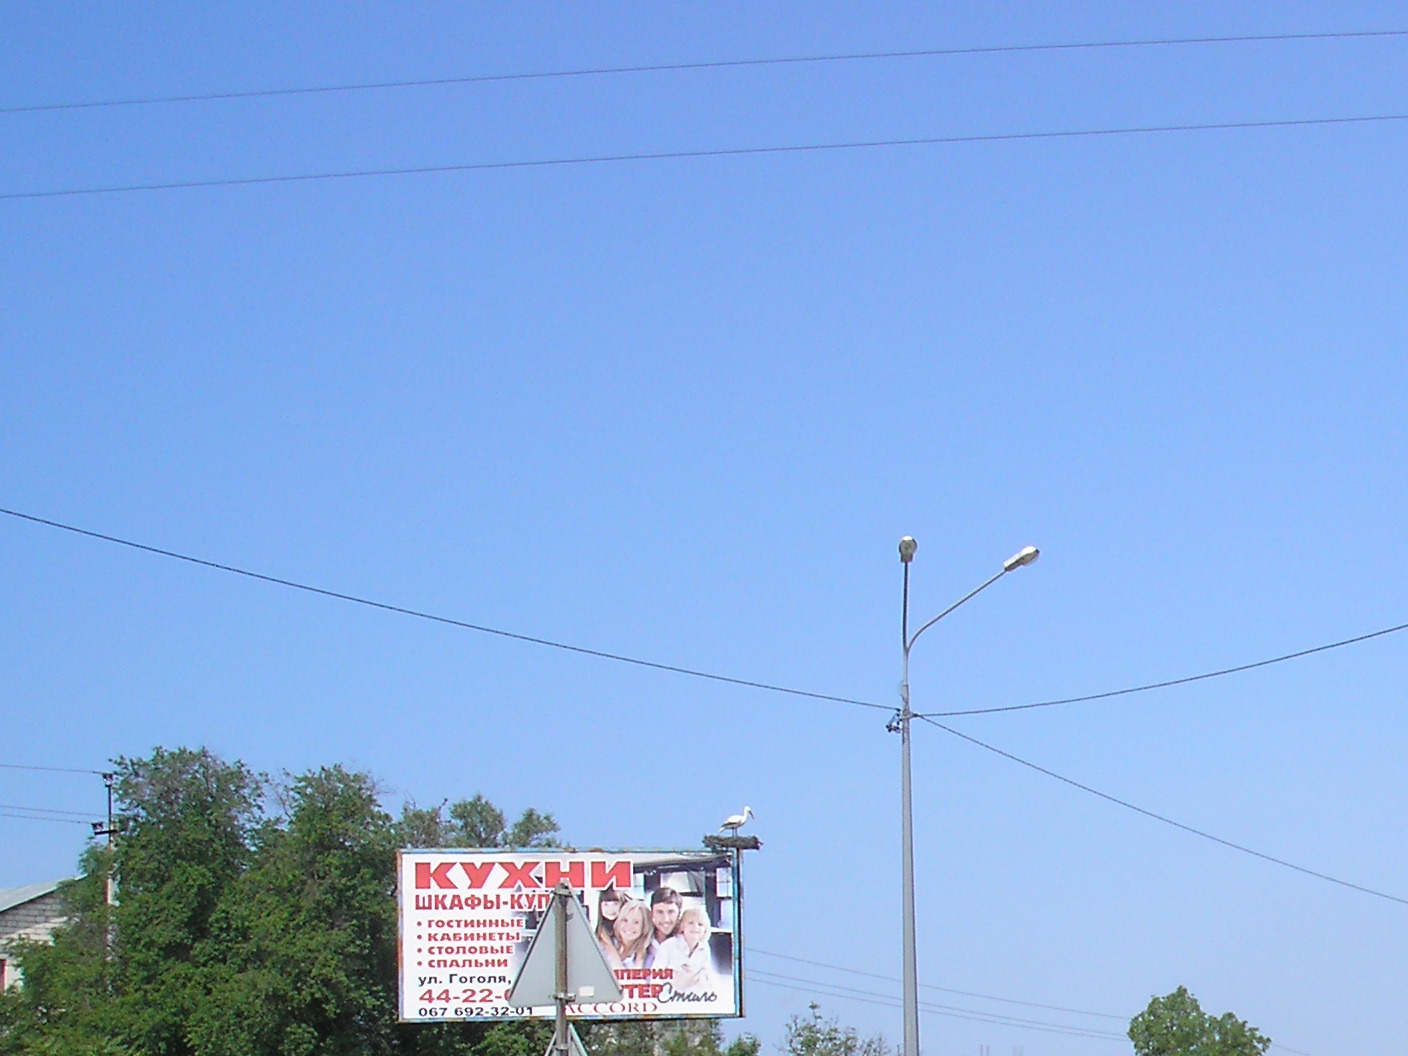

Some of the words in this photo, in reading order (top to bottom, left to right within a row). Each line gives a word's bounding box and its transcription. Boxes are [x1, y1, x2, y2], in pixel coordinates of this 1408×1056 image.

[415, 861, 631, 889] КУХНИ
[415, 893, 551, 910] ШКАФЫ-КУП
[427, 919, 523, 928] ГОСТИННЫЕ
[427, 932, 520, 941] КАБИНЕТЫ
[427, 945, 513, 955] СТОЛОВЫЕ
[427, 958, 508, 968] СПАЛЬНИ
[418, 975, 443, 987] ул.
[449, 973, 512, 985] Гоголя,
[621, 983, 663, 998] ТЕР
[418, 1007, 448, 1017] 067
[454, 1006, 533, 1017] 692-32-01
